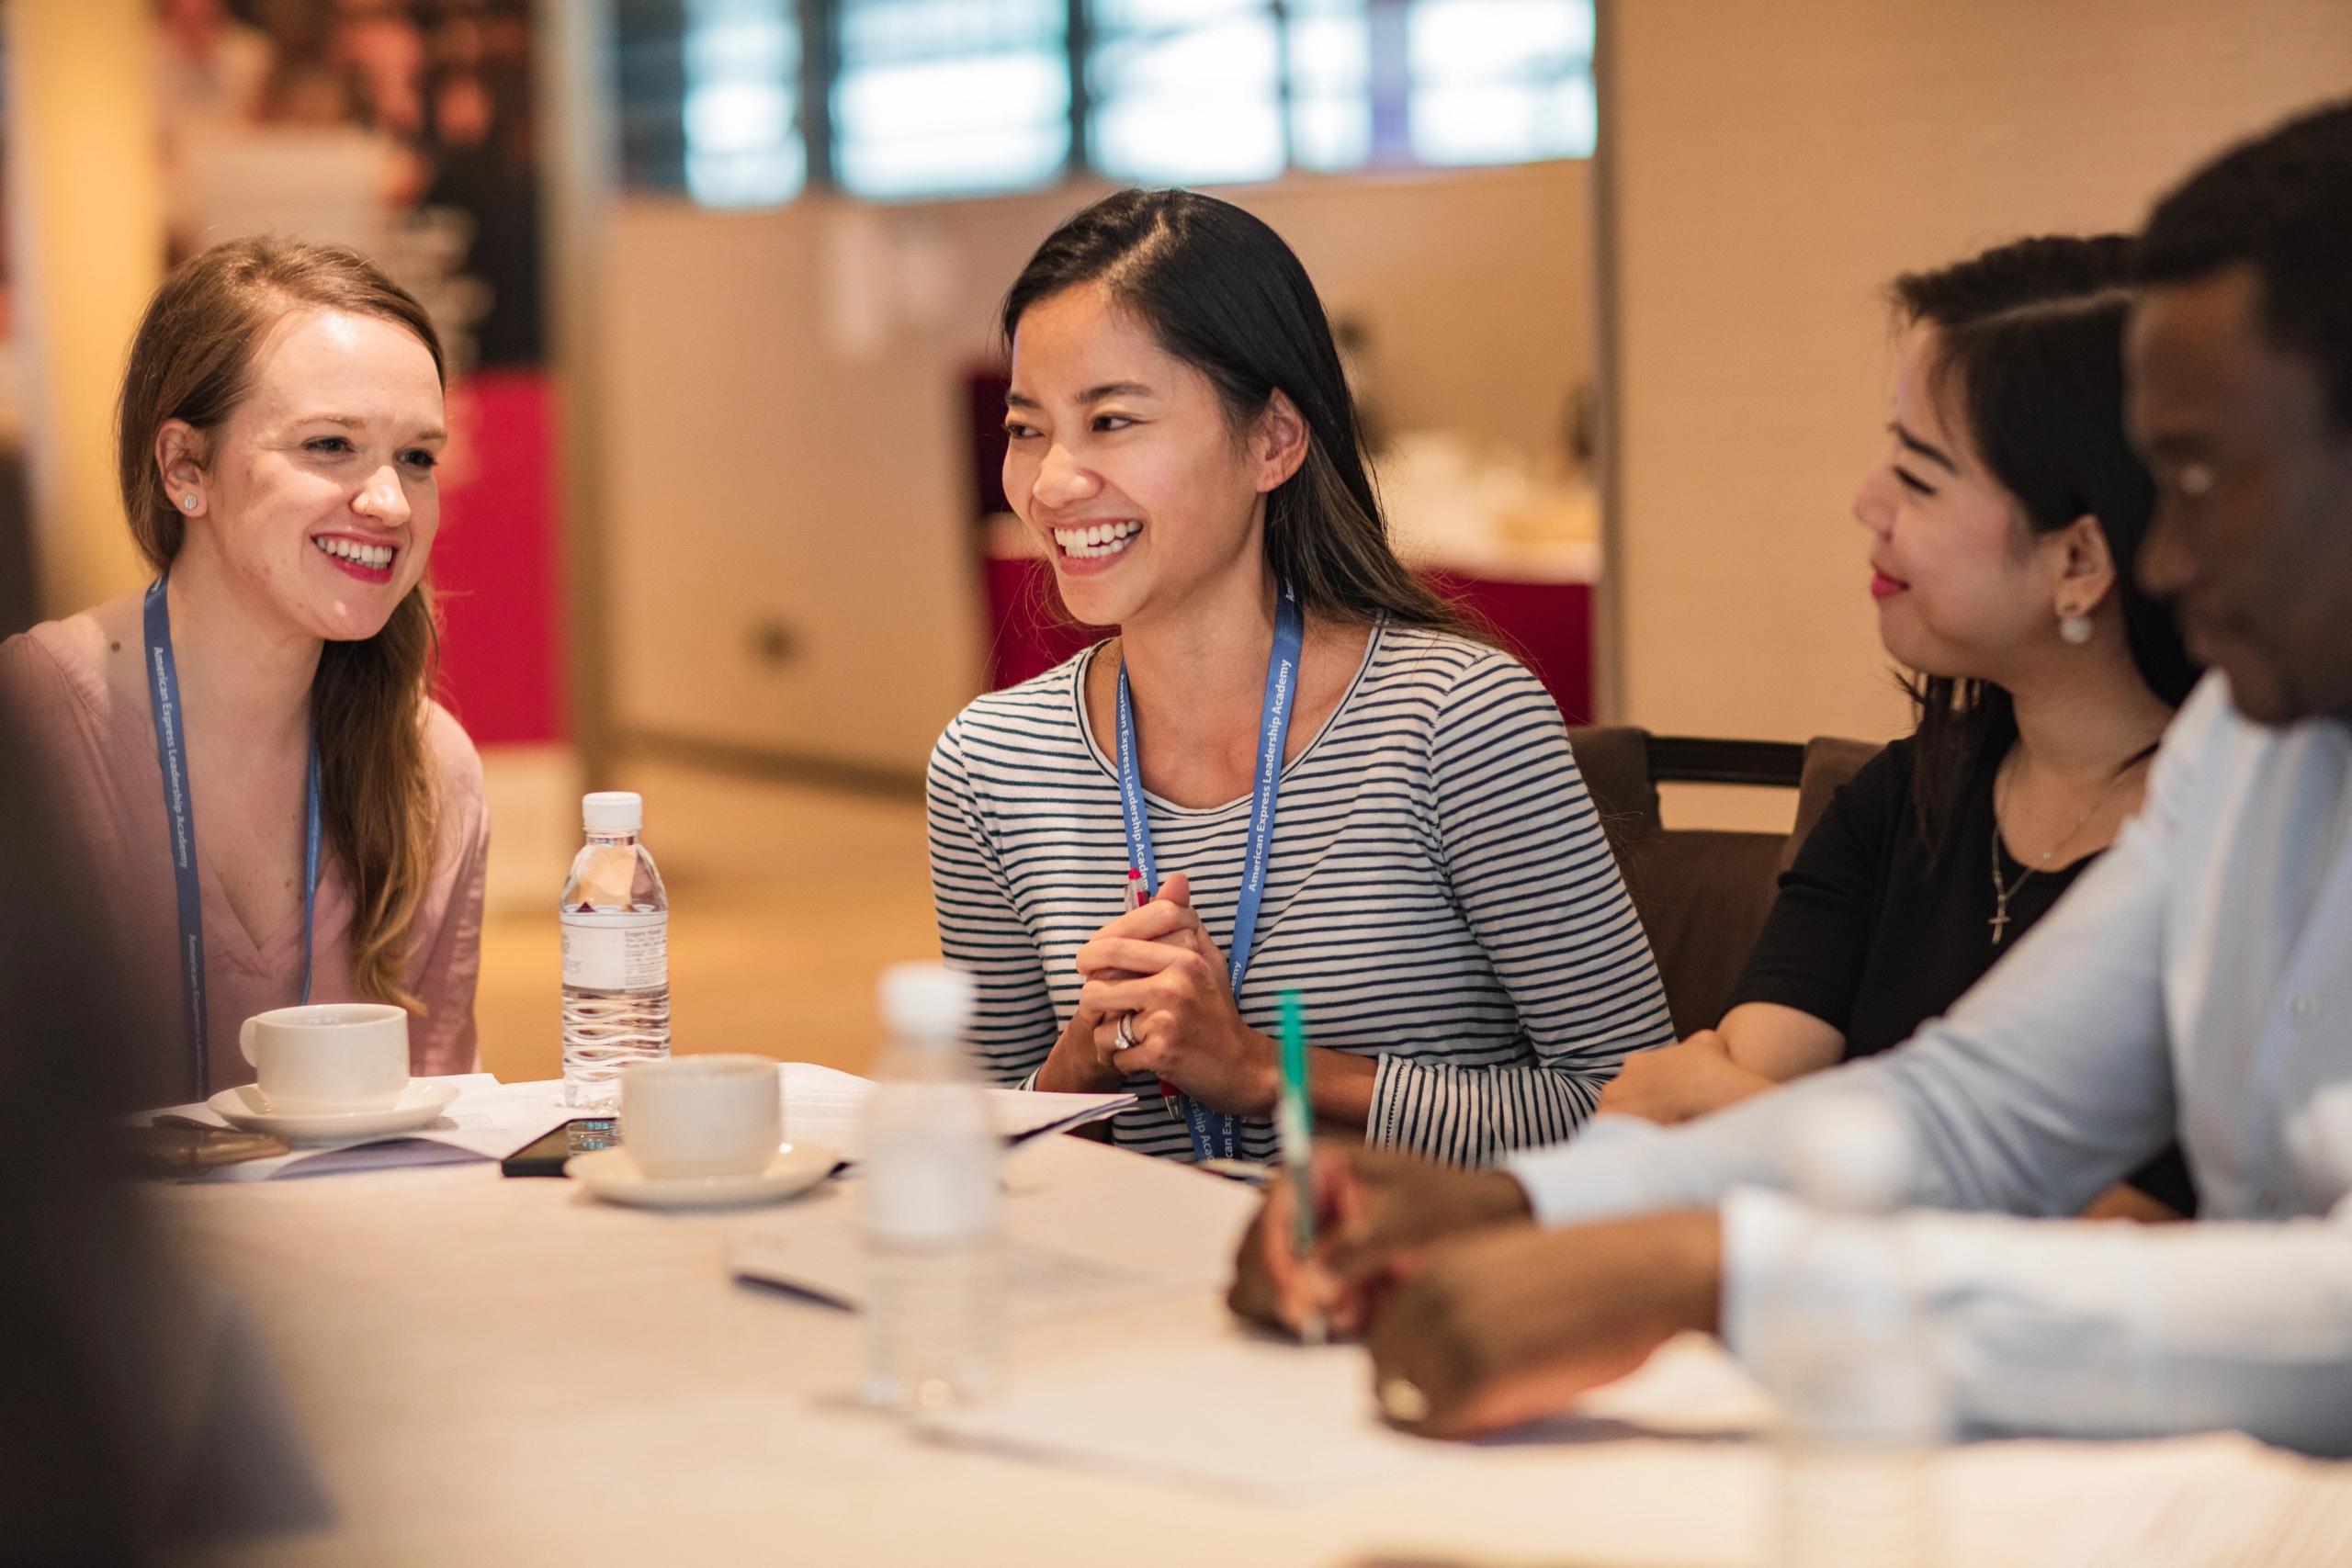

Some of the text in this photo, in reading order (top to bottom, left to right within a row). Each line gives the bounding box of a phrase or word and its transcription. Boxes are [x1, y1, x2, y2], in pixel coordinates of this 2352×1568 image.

[153, 647, 188, 870] American Express Leadership Academy
[1121, 729, 1131, 775] Express
[1249, 659, 1292, 893] American Express Leadership Academy
[1125, 776, 1143, 841] Leadership
[1136, 842, 1148, 891] Academ
[1231, 961, 1241, 993] emy
[1222, 1113, 1234, 1135] Exp
